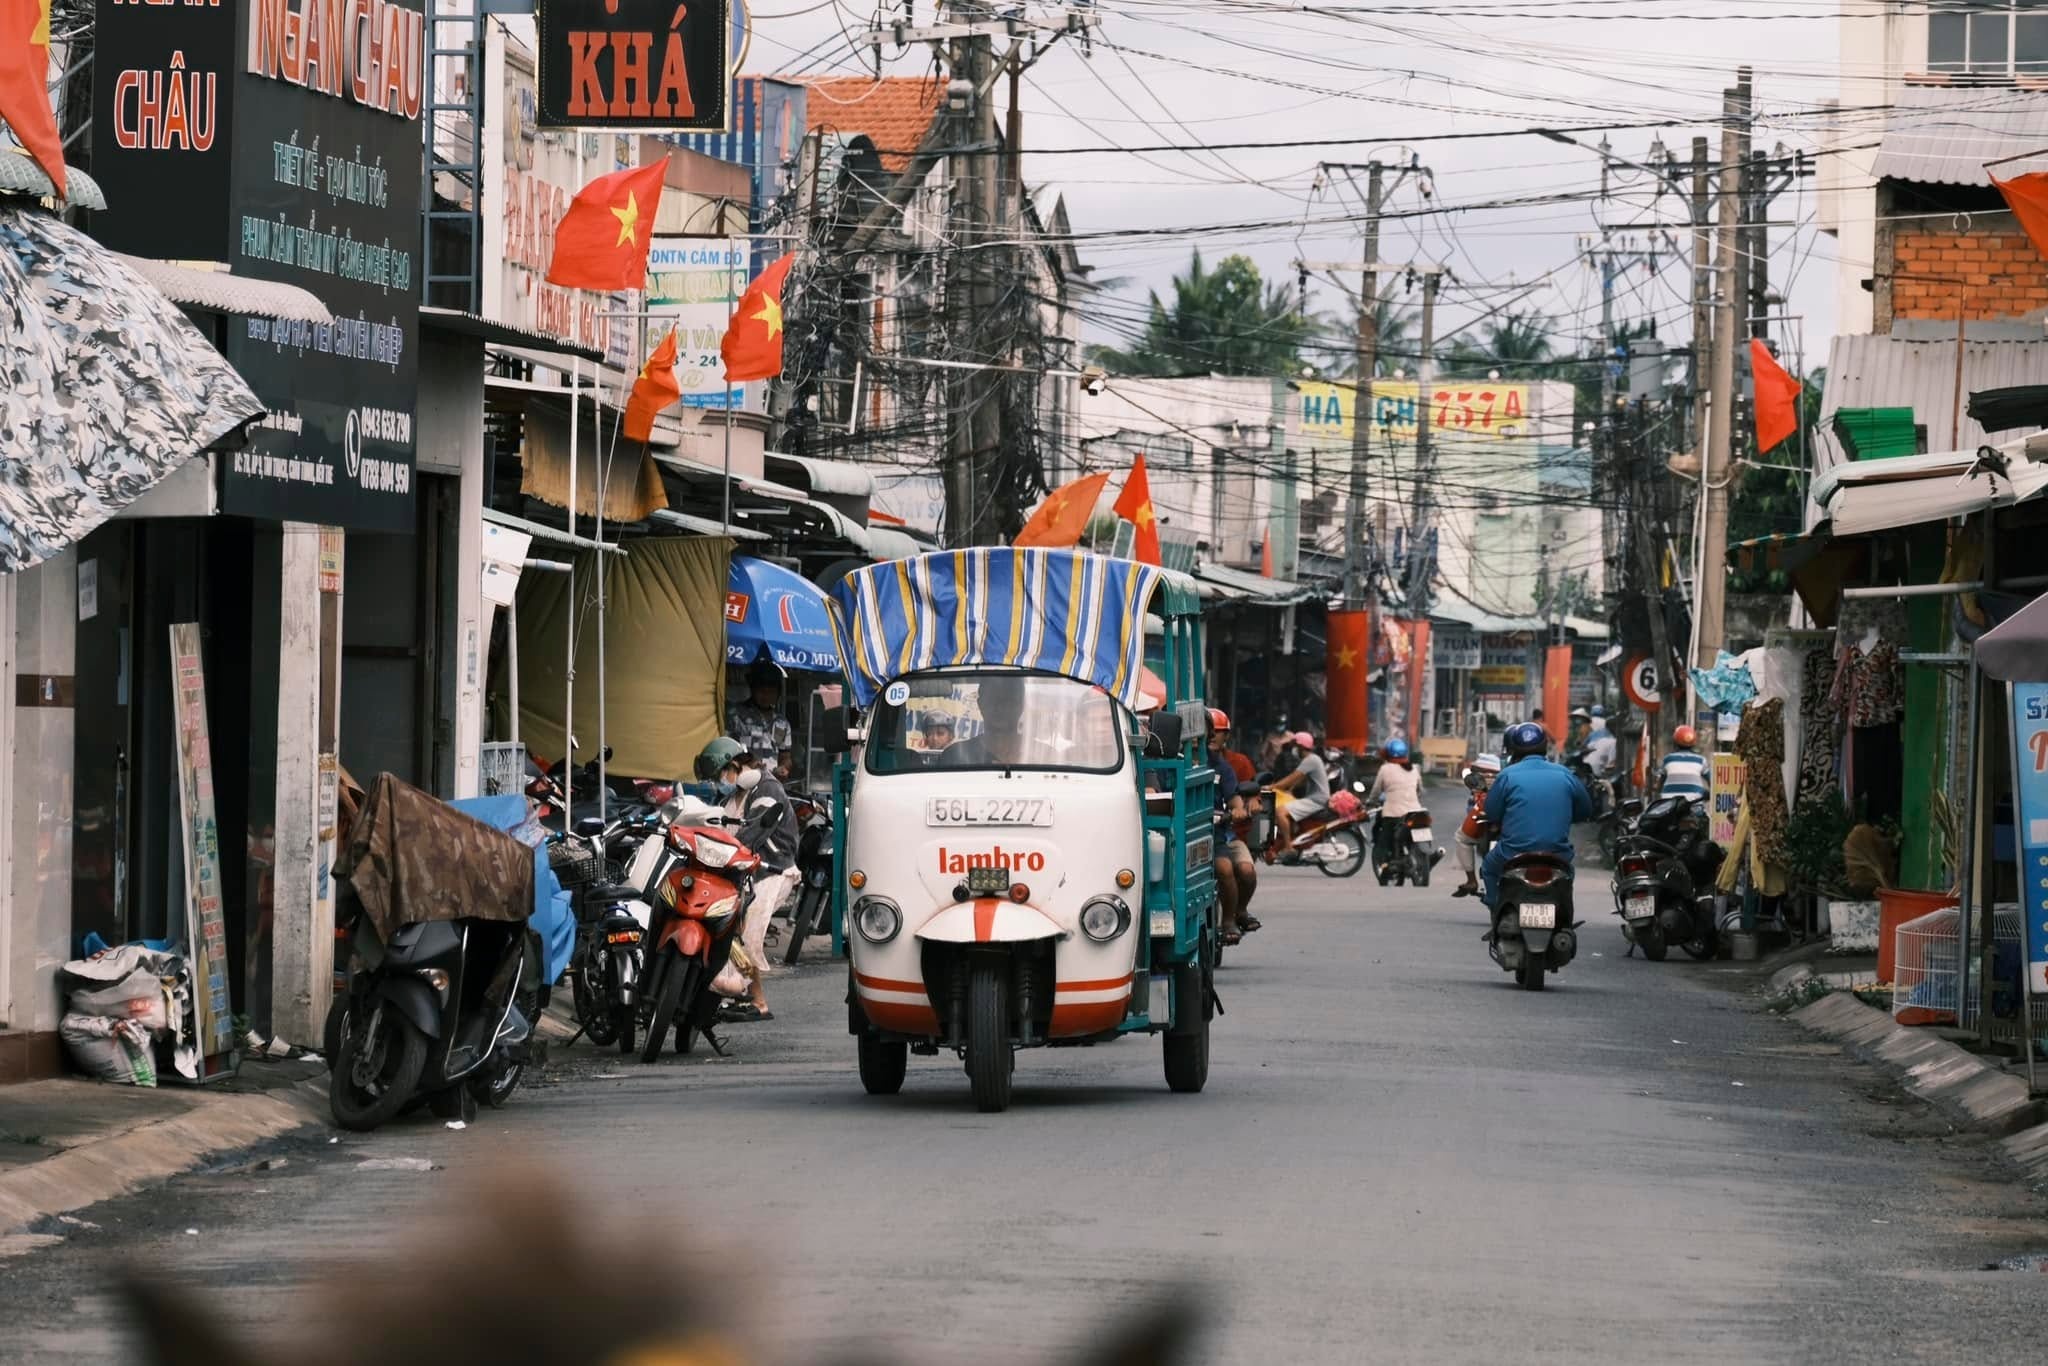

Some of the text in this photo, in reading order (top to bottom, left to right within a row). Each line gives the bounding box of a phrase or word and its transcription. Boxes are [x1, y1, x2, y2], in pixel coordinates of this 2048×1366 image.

[567, 3, 695, 117] KHÁ
[114, 50, 216, 151] CHÂU
[273, 129, 304, 187] THIẾT
[326, 155, 345, 206] TẠO
[368, 155, 388, 208] TÓC
[241, 215, 270, 260] PHUN
[391, 249, 410, 292] CAO
[651, 248, 687, 264] DNTN
[776, 645, 807, 664] BẢO
[890, 687, 905, 700] 05
[938, 846, 1046, 873] lambro
